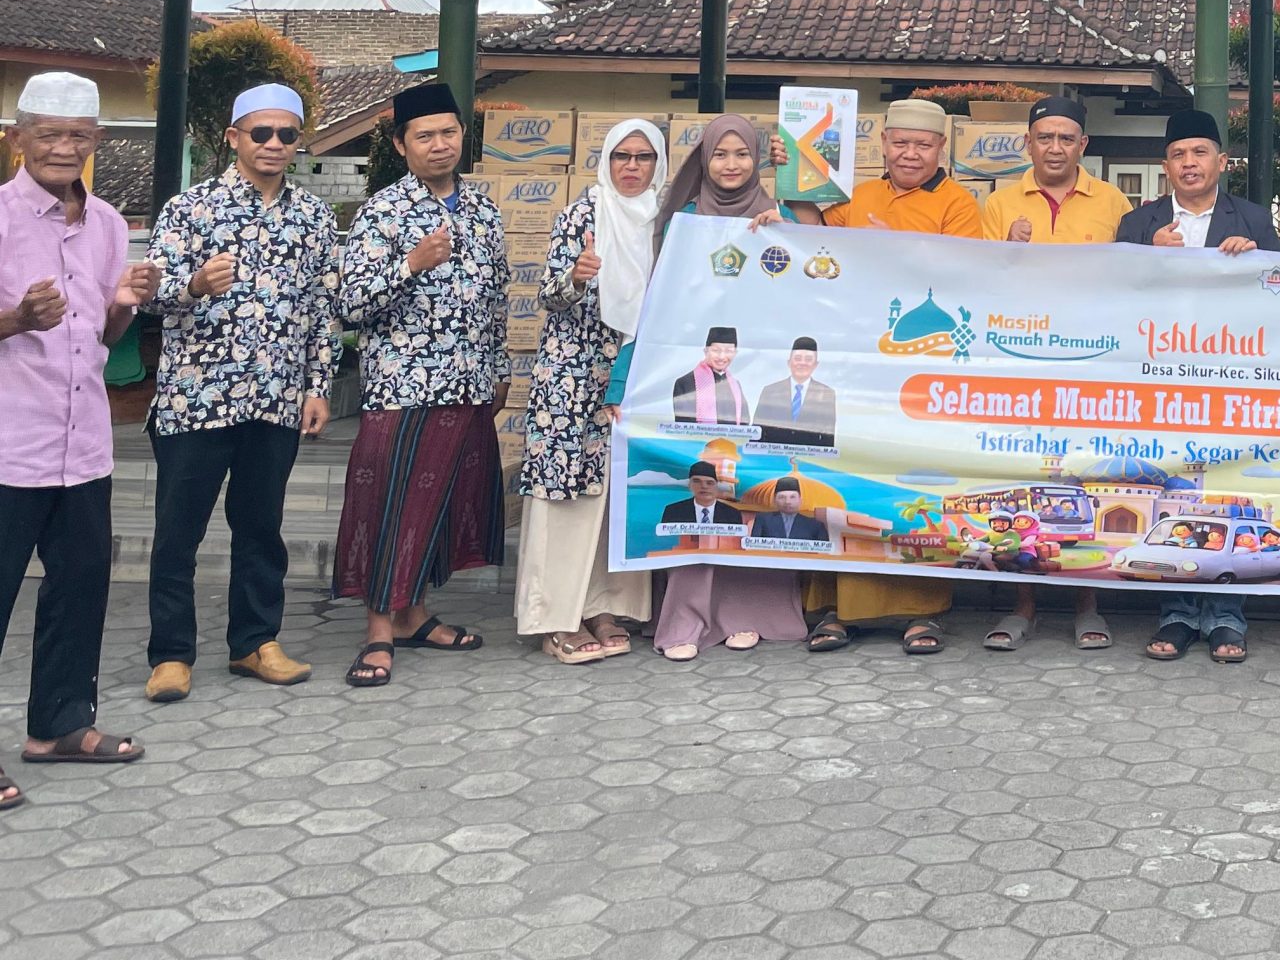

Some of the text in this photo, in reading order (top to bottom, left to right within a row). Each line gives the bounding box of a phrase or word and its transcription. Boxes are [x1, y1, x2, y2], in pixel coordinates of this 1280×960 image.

[498, 117, 553, 141] AGRO
[966, 134, 1026, 159] AGRO
[504, 181, 557, 201] AGRO
[986, 313, 1050, 334] Masjid
[986, 331, 1121, 351] Ramah Pemudik
[1137, 318, 1269, 360] Ishlahul
[1141, 361, 1173, 377] Desa
[927, 381, 1042, 418] Selamat
[1053, 386, 1142, 423] Mudik
[1153, 391, 1212, 426] Idul
[975, 431, 1069, 456] Istirahat
[1088, 435, 1164, 461] Ibadah
[1183, 440, 1244, 466] Segar
[897, 537, 942, 546] MUDIK
